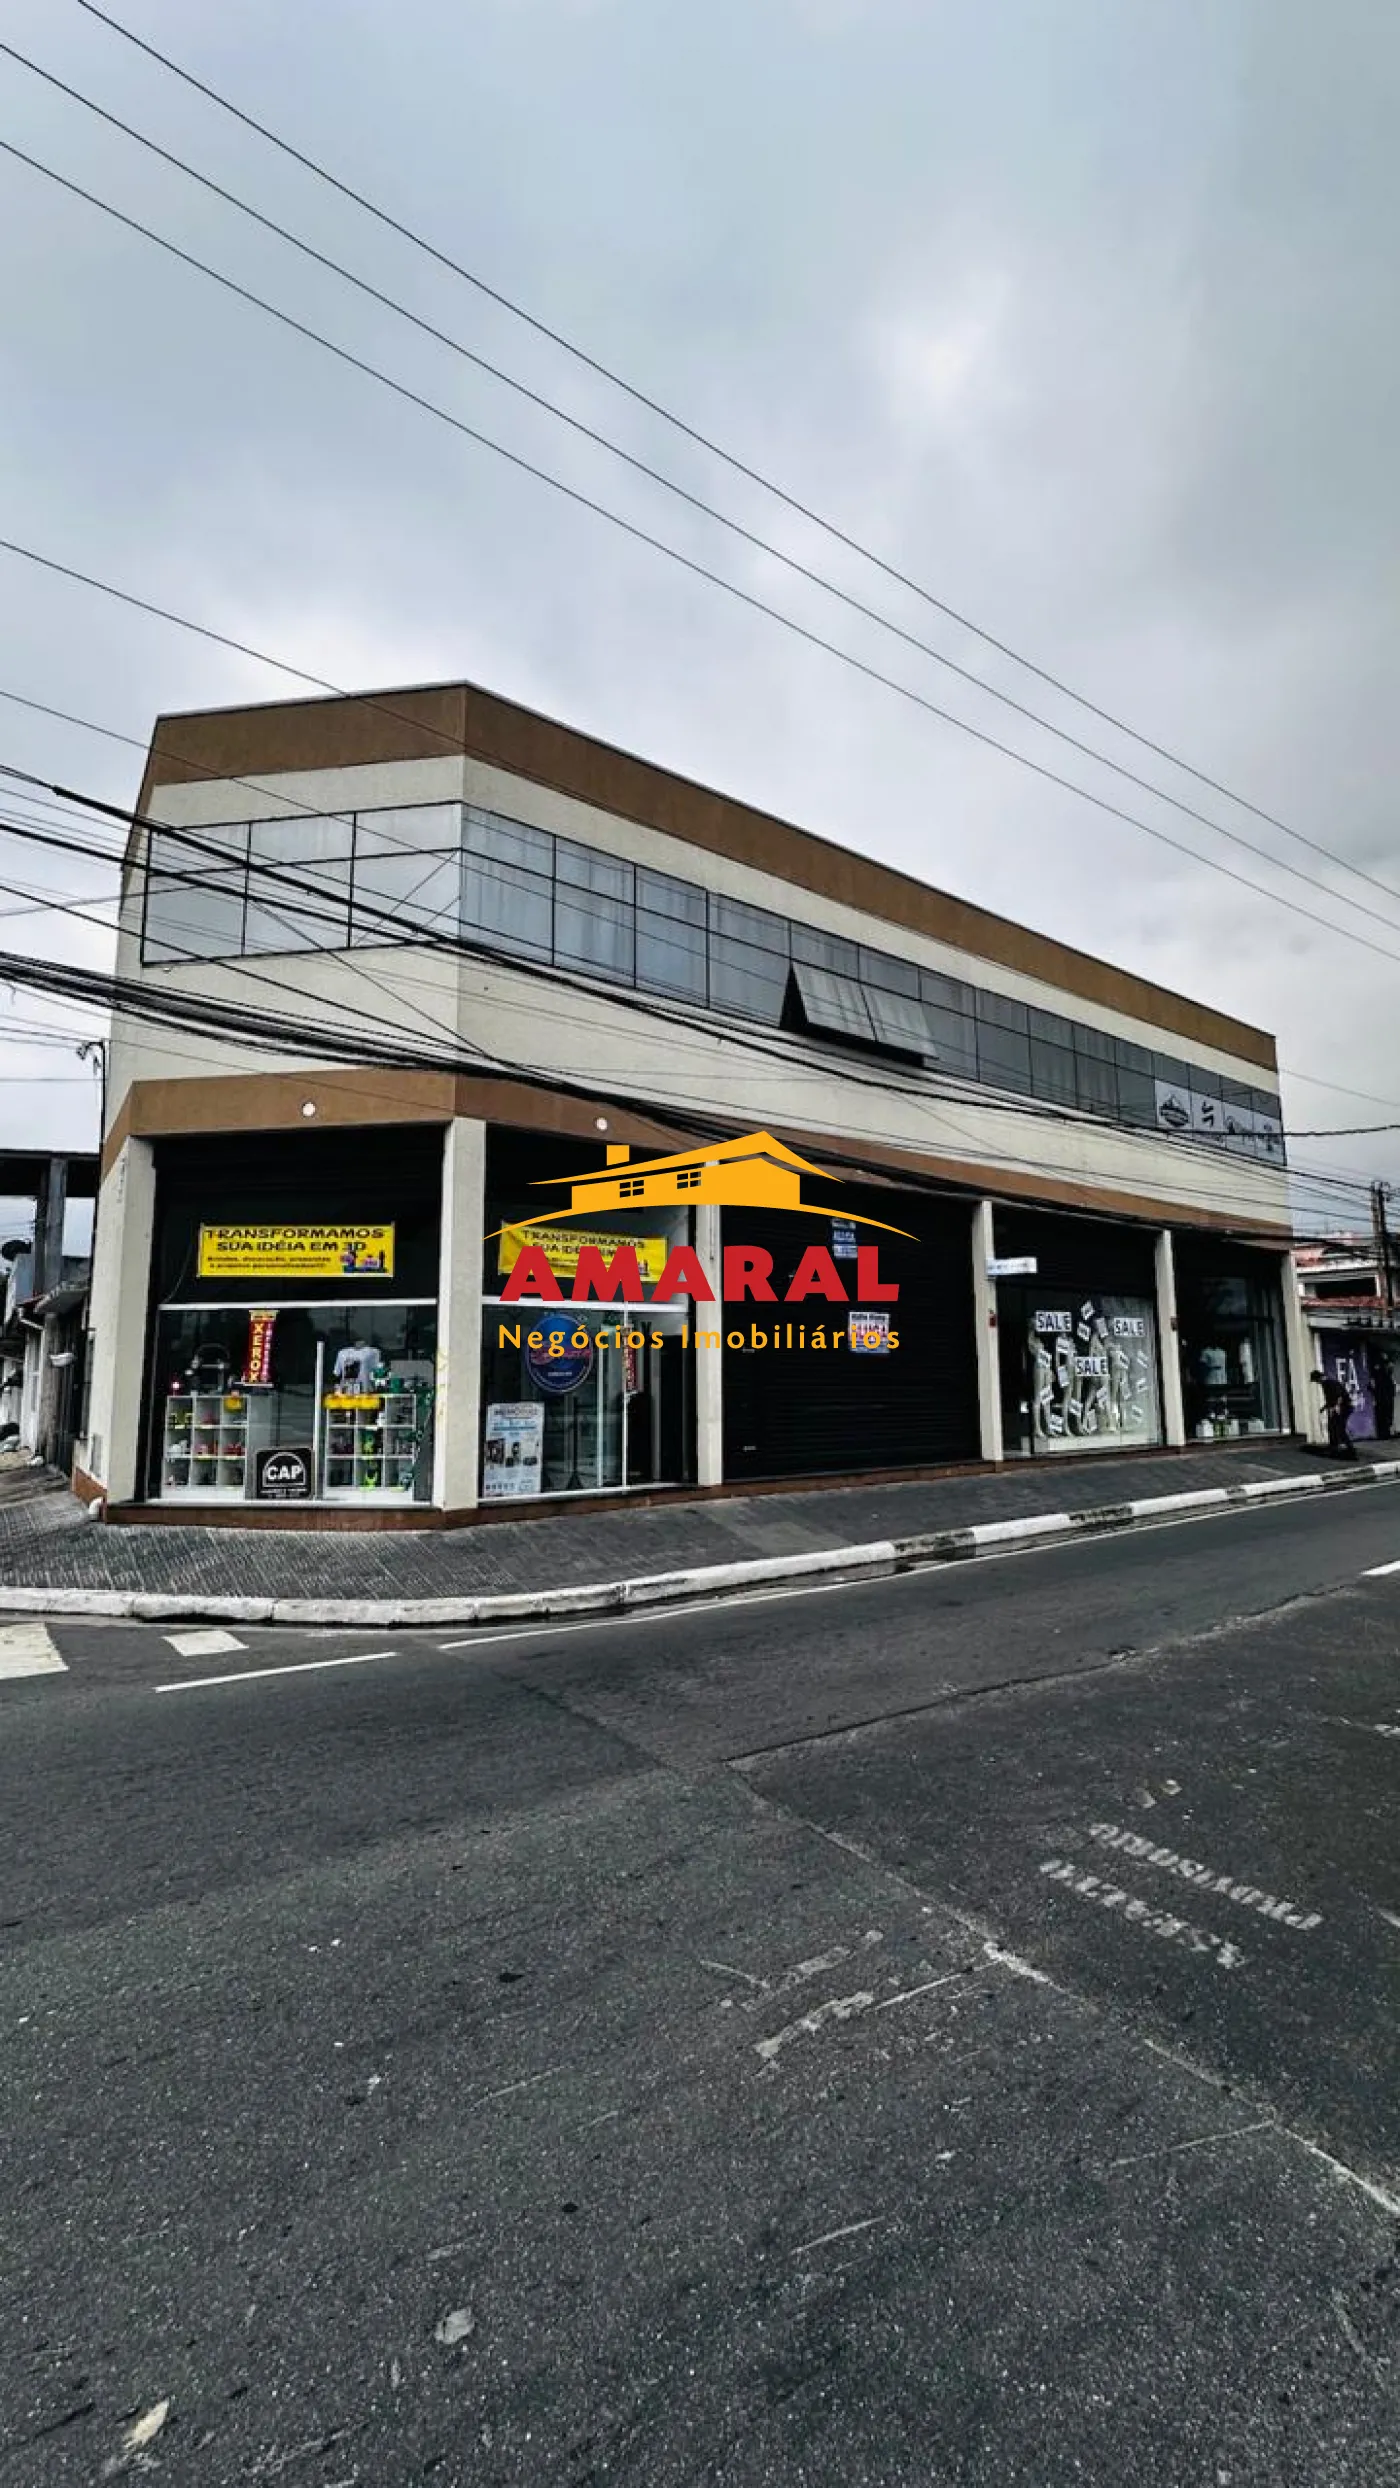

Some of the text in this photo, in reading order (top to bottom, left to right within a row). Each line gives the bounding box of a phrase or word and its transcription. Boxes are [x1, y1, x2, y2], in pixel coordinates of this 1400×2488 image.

[205, 1228, 384, 1239] TRANSFORMAMOS
[217, 1242, 253, 1251] SUA
[257, 1240, 306, 1251] IDÉIA
[311, 1242, 338, 1251] EM
[1036, 1312, 1071, 1332] SALE
[1114, 1318, 1143, 1336] SALE
[1076, 1357, 1107, 1375] SALE
[267, 1465, 303, 1480] CAP
